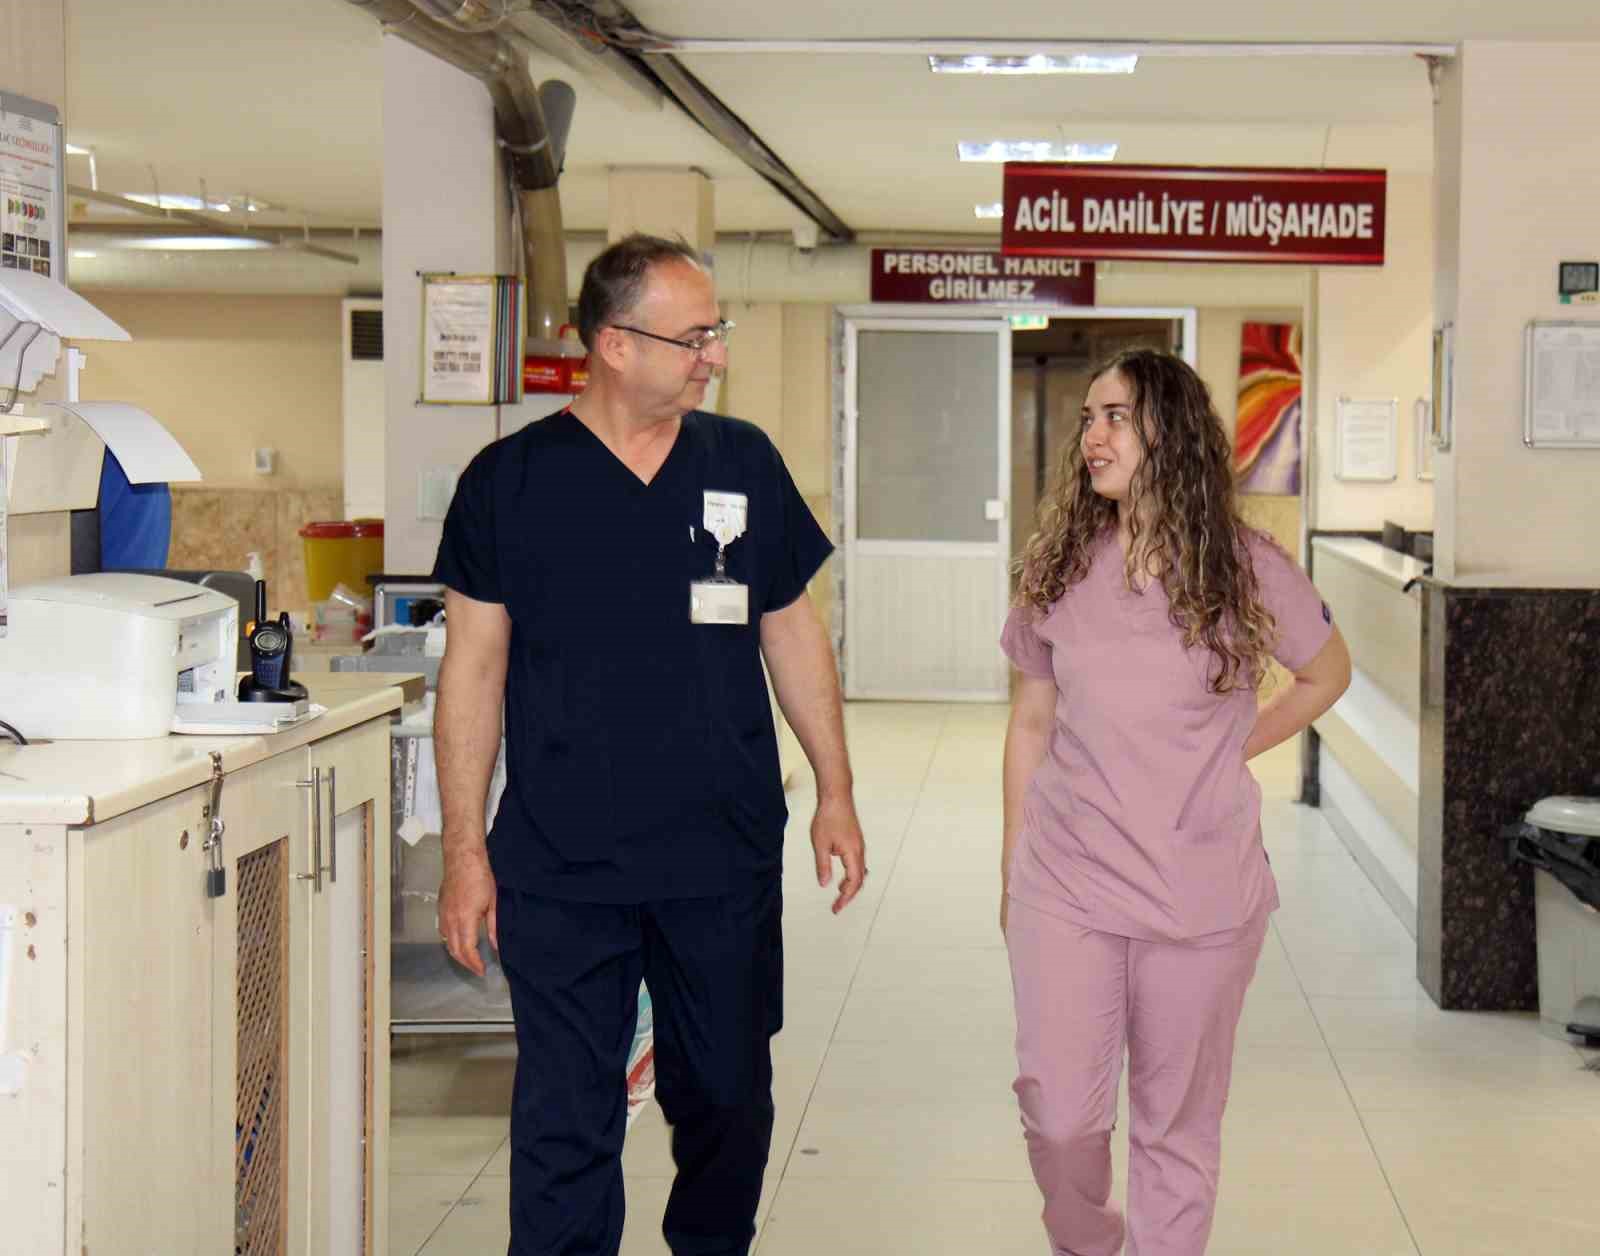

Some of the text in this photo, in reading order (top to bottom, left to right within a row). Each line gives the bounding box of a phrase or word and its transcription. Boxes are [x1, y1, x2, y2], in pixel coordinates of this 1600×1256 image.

[1014, 189, 1374, 246] ACİL DAHİLİYE / MÜŞAHADE
[884, 252, 999, 275] PERSONEL
[929, 274, 1035, 300] GİRİLMEZ
